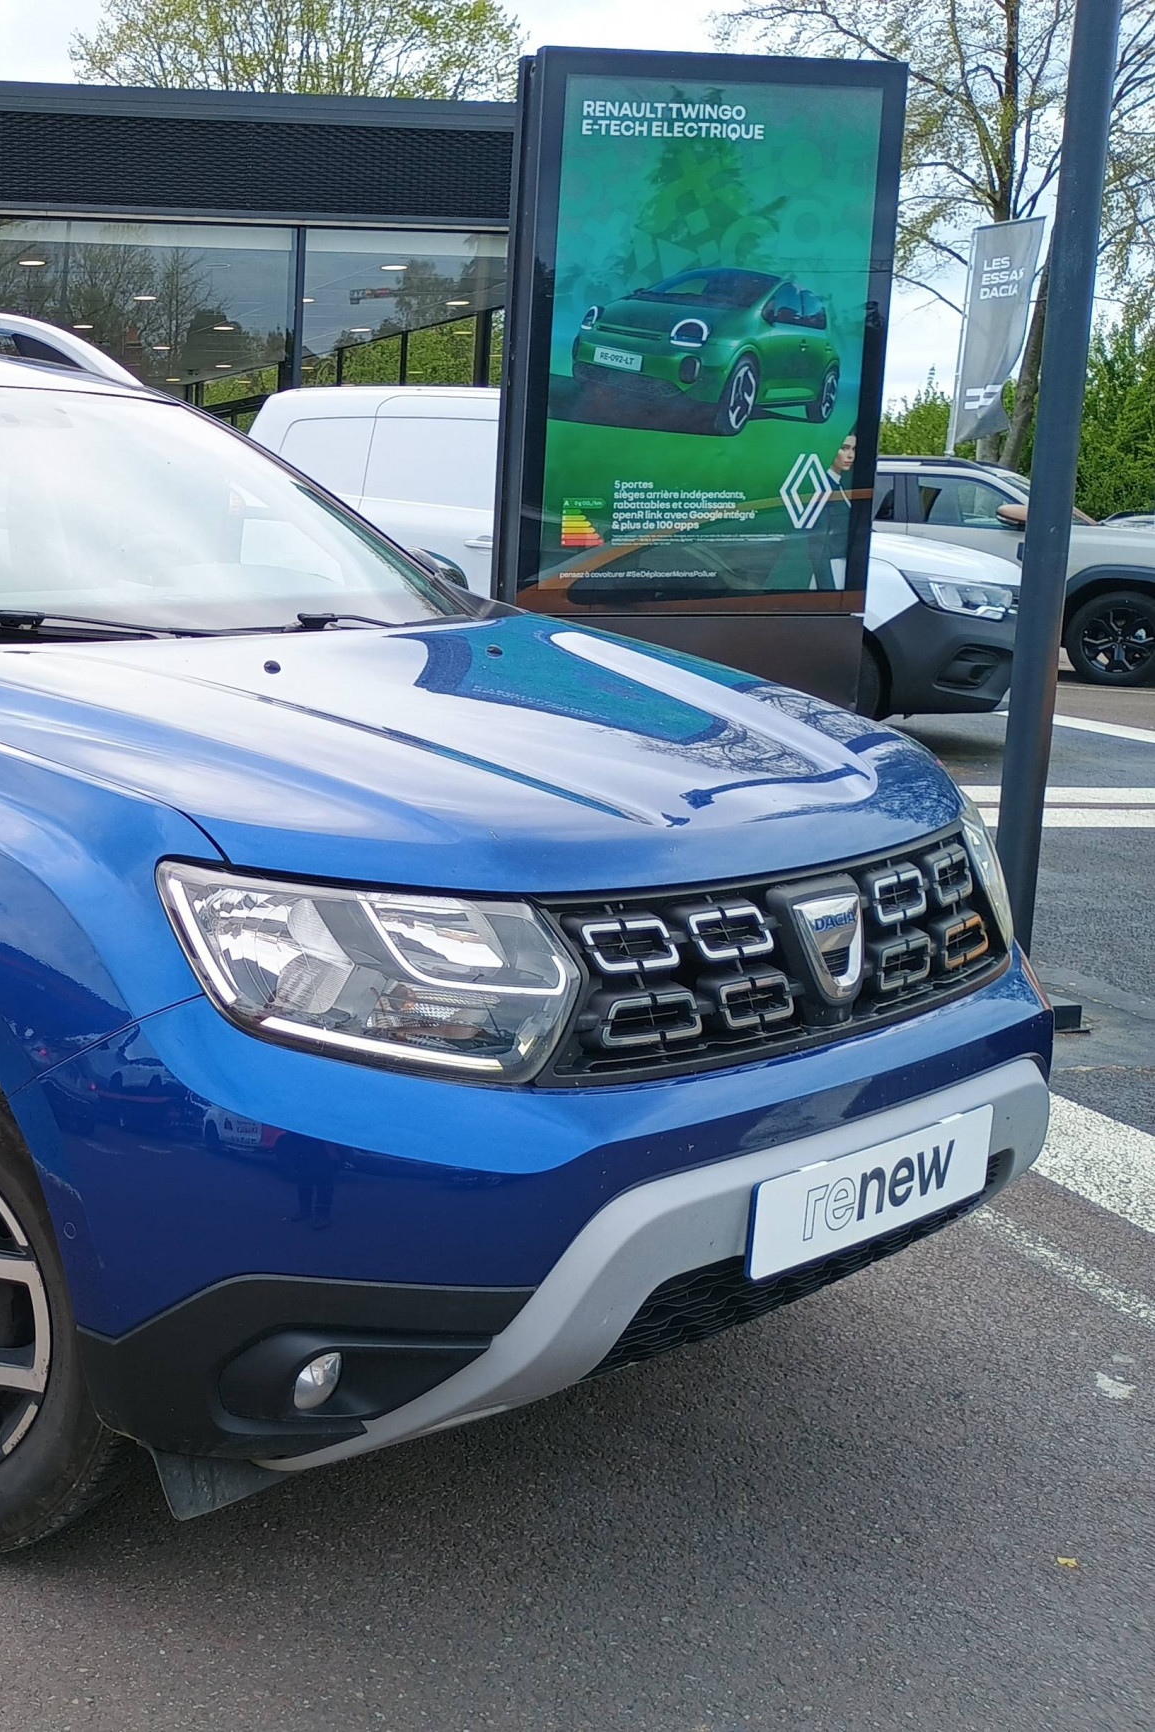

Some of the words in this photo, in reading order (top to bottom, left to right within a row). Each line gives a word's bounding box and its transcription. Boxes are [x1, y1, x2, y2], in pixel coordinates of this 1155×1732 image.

[583, 100, 667, 118] RENAULT
[669, 103, 746, 120] TWINGO
[581, 119, 647, 137] E-TECH
[651, 121, 765, 141] ELECTRIQUE
[983, 256, 1010, 270] LES
[600, 352, 634, 365] RE-092-LT
[614, 480, 620, 489] 5
[621, 481, 654, 491] portes
[613, 489, 645, 501] sièges
[646, 490, 679, 499] arrière
[680, 490, 746, 501] indépendants,
[613, 500, 670, 509] rabattables
[672, 501, 682, 509] et
[683, 500, 736, 509] coulissants
[612, 510, 644, 521] openR
[645, 510, 663, 519] link
[689, 510, 723, 521] Google
[611, 521, 619, 530] &
[620, 521, 641, 531] plus
[642, 521, 655, 529] de
[656, 521, 673, 529] 100
[674, 522, 700, 531] apps
[814, 909, 856, 932] DACIA
[802, 1139, 956, 1242] renew
